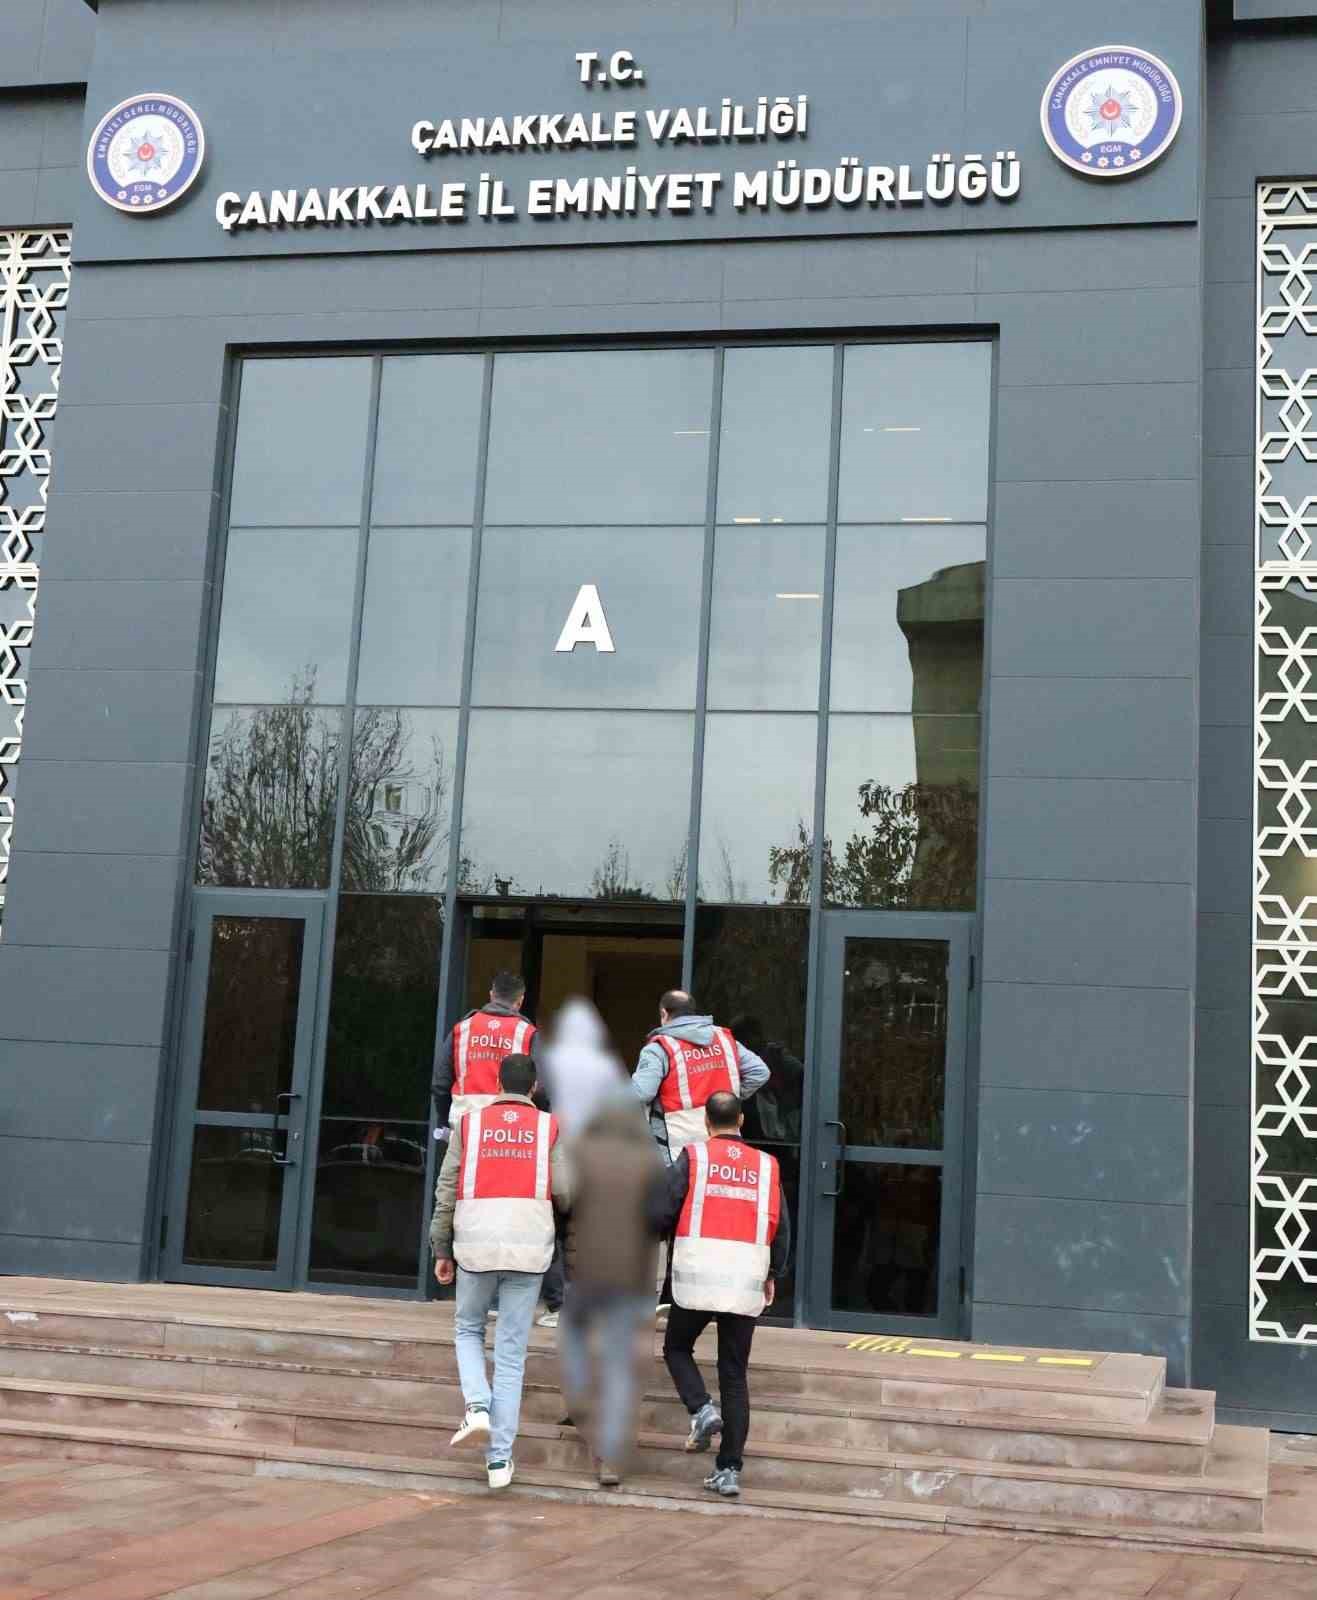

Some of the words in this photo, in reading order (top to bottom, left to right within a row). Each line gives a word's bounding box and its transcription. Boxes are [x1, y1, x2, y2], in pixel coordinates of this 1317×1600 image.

[575, 50, 643, 82] T.C.
[411, 111, 636, 154] ÇANAKKALE
[646, 95, 808, 140] VALİLİĞİ
[215, 183, 466, 230] ÇANAKKALE
[478, 172, 515, 216] İL
[528, 166, 721, 215] EMNİYET
[733, 151, 1020, 206] MÜDÜRLÜĞÜ
[554, 584, 616, 653] A
